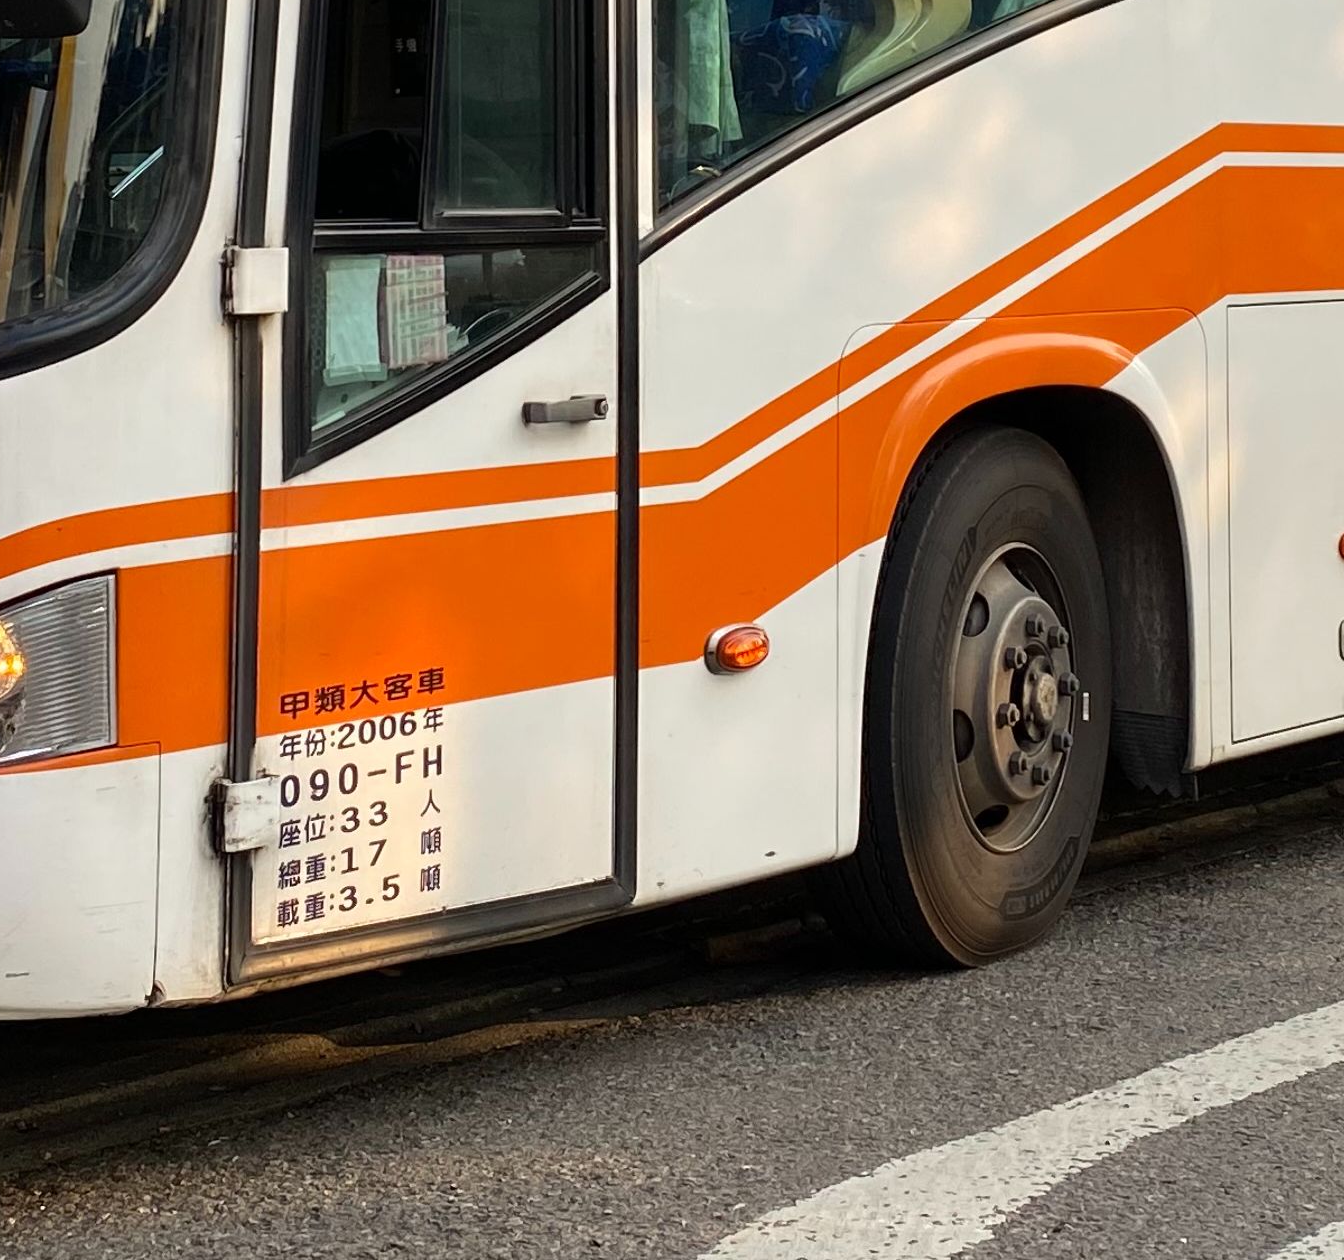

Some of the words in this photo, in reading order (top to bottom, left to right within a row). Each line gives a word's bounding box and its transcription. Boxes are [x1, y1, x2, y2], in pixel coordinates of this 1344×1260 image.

[280, 667, 445, 720] 甲類大客車
[280, 744, 443, 808] 090-FH
